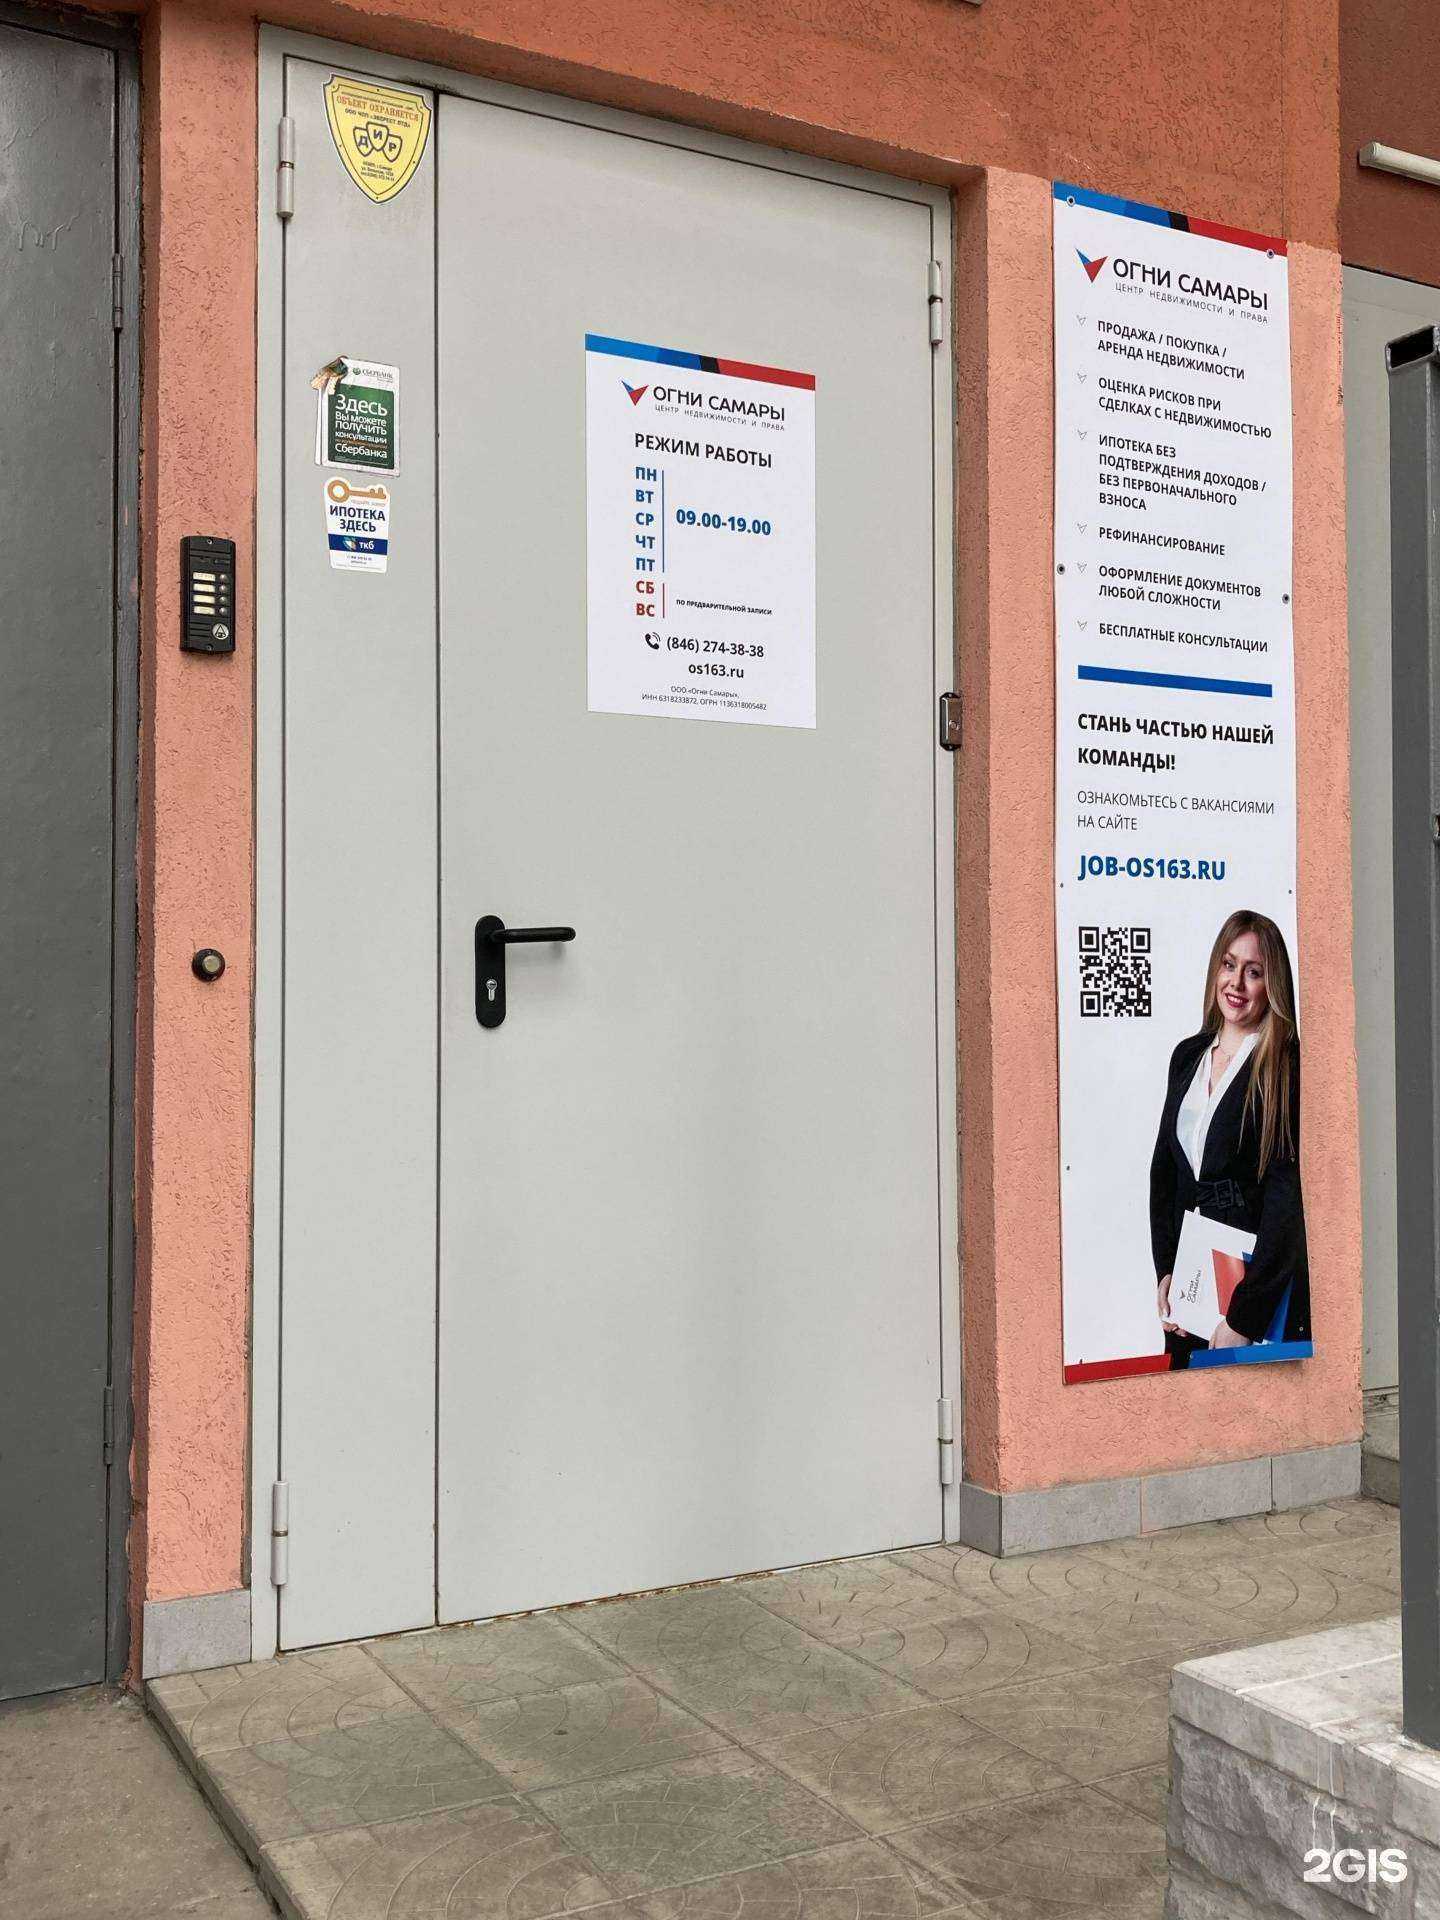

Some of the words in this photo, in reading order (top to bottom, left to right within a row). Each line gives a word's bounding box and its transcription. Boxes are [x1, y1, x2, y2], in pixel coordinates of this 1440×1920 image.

[1113, 259, 1171, 288] ОГНИ
[1178, 274, 1268, 310] САМАРЫ
[1115, 282, 1144, 294] ЦЕНТР
[1149, 290, 1223, 314] НЕДВИЖИМОСТИ
[1228, 308, 1235, 316] И
[1240, 310, 1268, 323] ПРАВА
[1098, 320, 1156, 343] ПРОДАЖА
[1166, 335, 1219, 356] ПОКУПКА
[1098, 340, 1144, 360] АРЕНДА
[1146, 350, 1245, 379] НЕДВИЖИМОСТИ
[335, 394, 388, 416] Здесь
[653, 386, 703, 408] ОГНИ
[708, 396, 785, 421] САМАРЫ
[1098, 377, 1146, 397] ОЦЕНКА
[1149, 387, 1195, 405] РИСКОВ
[1198, 397, 1221, 411] ПРИ
[335, 411, 350, 421] Вы
[350, 414, 387, 427] можете
[655, 405, 680, 414] ЦЕНТР
[684, 409, 747, 425] НЕДВИЖИМОСТИ
[761, 421, 785, 431] ПРАВА
[1098, 396, 1151, 417] СДЕЛКАХ
[1154, 408, 1162, 418] С
[1164, 409, 1272, 438] НЕДВИЖИМОСТЬЮ
[335, 431, 387, 444] консультации
[1099, 434, 1153, 454] ИПОТЕКА
[1156, 444, 1176, 458] БЕЗ
[335, 443, 388, 458] Сбербанка
[635, 433, 699, 457] РЕЖИМ
[705, 444, 772, 468] РАБОТЫ
[635, 466, 657, 481] ПН
[1099, 453, 1200, 481] ПОДТВЕРЖДЕНИЯ
[1203, 471, 1259, 491] ДОХОДОВ
[636, 489, 654, 503] ВТ
[1099, 473, 1119, 486] БЕЗ
[1123, 477, 1237, 505] ПЕРВОНАЧАЛЬНОГО
[1099, 492, 1147, 510] ВЗНОСА
[330, 505, 386, 521] ИПОТЕКА
[636, 512, 654, 526] СР
[676, 509, 771, 535] 09.00-19.00
[340, 519, 377, 532] ЗДЕСЬ
[359, 541, 375, 550] ткб
[636, 535, 655, 549] ЧТ
[1099, 526, 1225, 555] РЕФИНАНСИРОВАНИЕ
[636, 557, 655, 571] ПТ
[636, 580, 655, 594] СБ
[1099, 565, 1183, 587] ОФОРМЛЕНИЕ
[1185, 577, 1261, 597] ДОКУМЕНТОВ
[686, 599, 747, 613] ПРЕДВАРИТЕЛЬНОЙ
[747, 606, 772, 615] ЗАПИСИ
[1098, 584, 1145, 601] ЛЮБОЙ
[1148, 590, 1221, 610] СЛОЖНОСТИ
[636, 603, 655, 617] ВС
[666, 636, 700, 653] (846)
[703, 640, 765, 657] 274-38-38
[1099, 622, 1175, 642] БЕСПЛАТНЫЕ
[1178, 632, 1268, 653] КОНСУЛЬТАЦИИ
[688, 663, 744, 678] os163.ru
[642, 693, 658, 701] ИНН
[699, 698, 718, 706] ОГРН
[671, 686, 687, 694] ООО
[1077, 713, 1132, 733] СТАНЬ
[1136, 718, 1207, 739] ЧАСТЬЮ
[1212, 725, 1274, 744] НАШЕЙ
[1078, 748, 1175, 773] КОМАНДЫ!
[1077, 790, 1177, 809] ОЗНАКОМЬТЕСЬ
[1180, 798, 1188, 809] С
[1191, 798, 1274, 814] ВАКАНСИЯМИ
[1077, 815, 1094, 828] НА
[1098, 814, 1138, 830] САЙТЕ
[1078, 855, 1225, 880] JOB-OS163.RU
